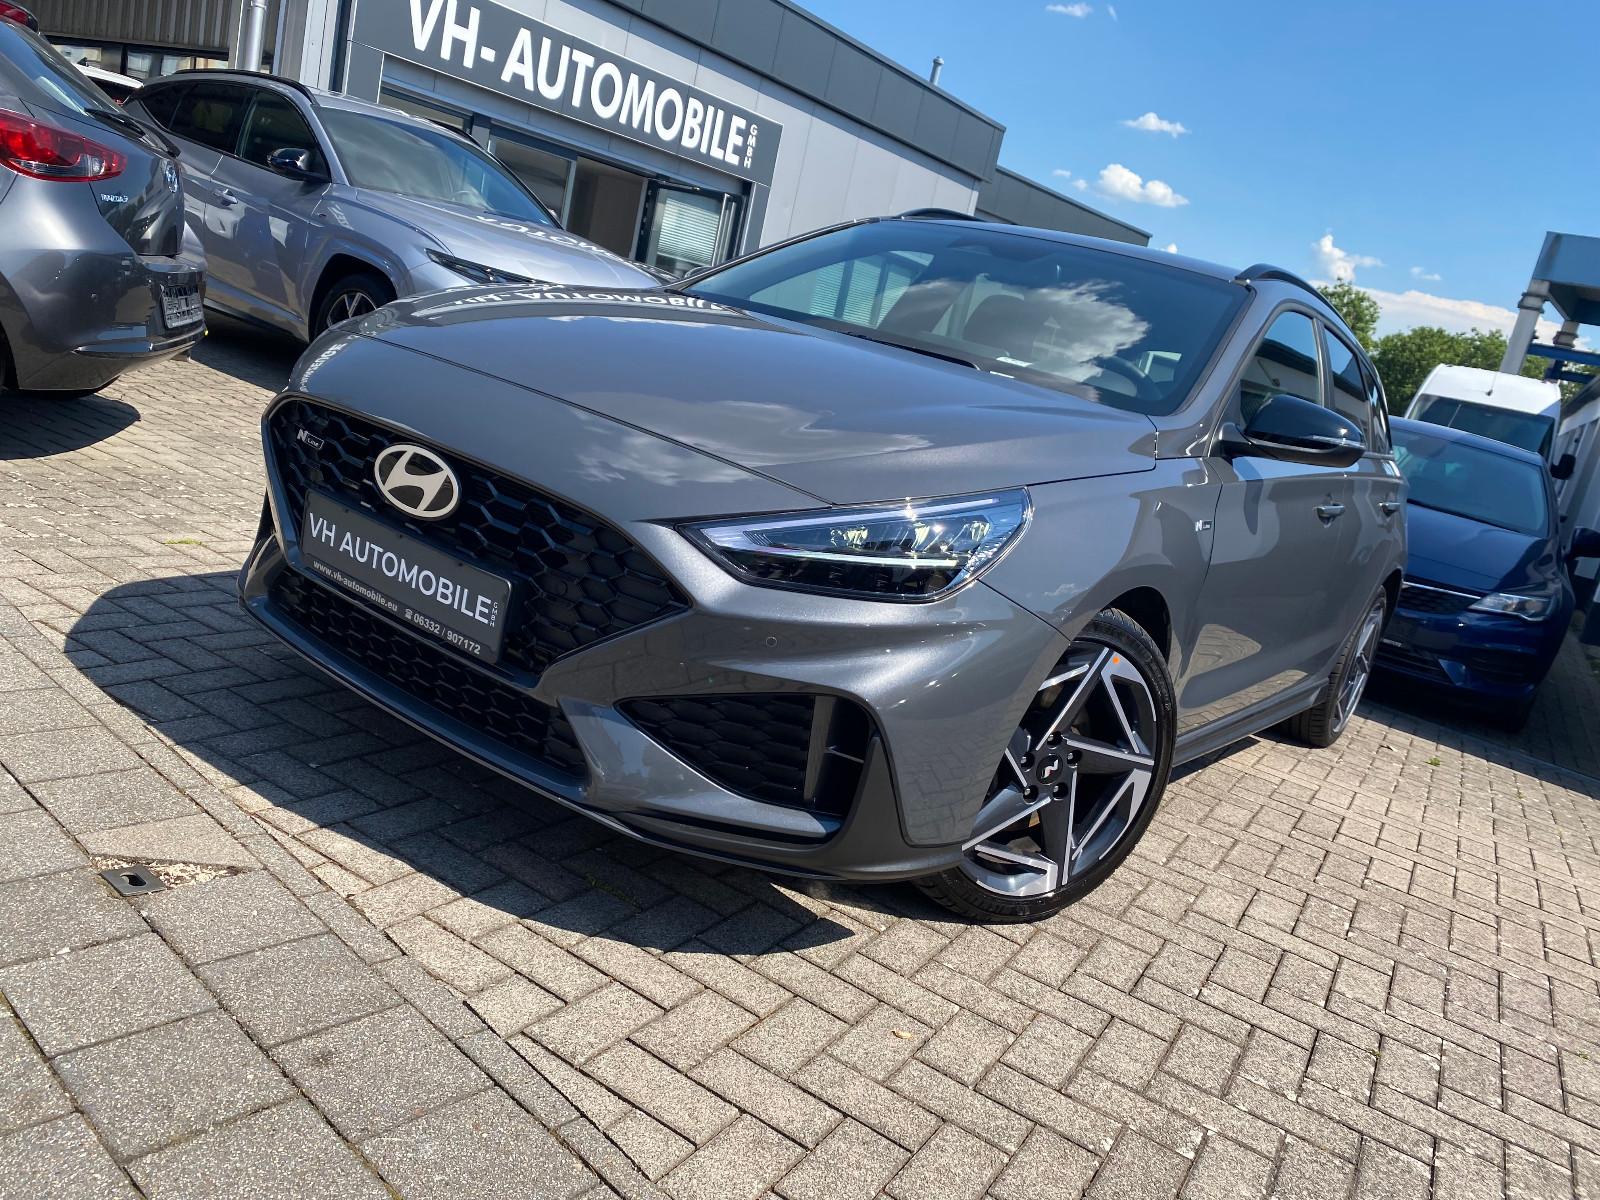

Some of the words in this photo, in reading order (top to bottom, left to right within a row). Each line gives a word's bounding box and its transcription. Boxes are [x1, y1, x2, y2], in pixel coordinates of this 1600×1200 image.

[409, 0, 496, 69] VH-
[501, 27, 747, 166] AUTOMOBILE
[309, 512, 336, 547] VH
[339, 531, 492, 625] AUTOMOBILE
[313, 560, 398, 612] www.vh-automobile.eu
[413, 613, 440, 634] 06332
[446, 630, 481, 655] 907172
